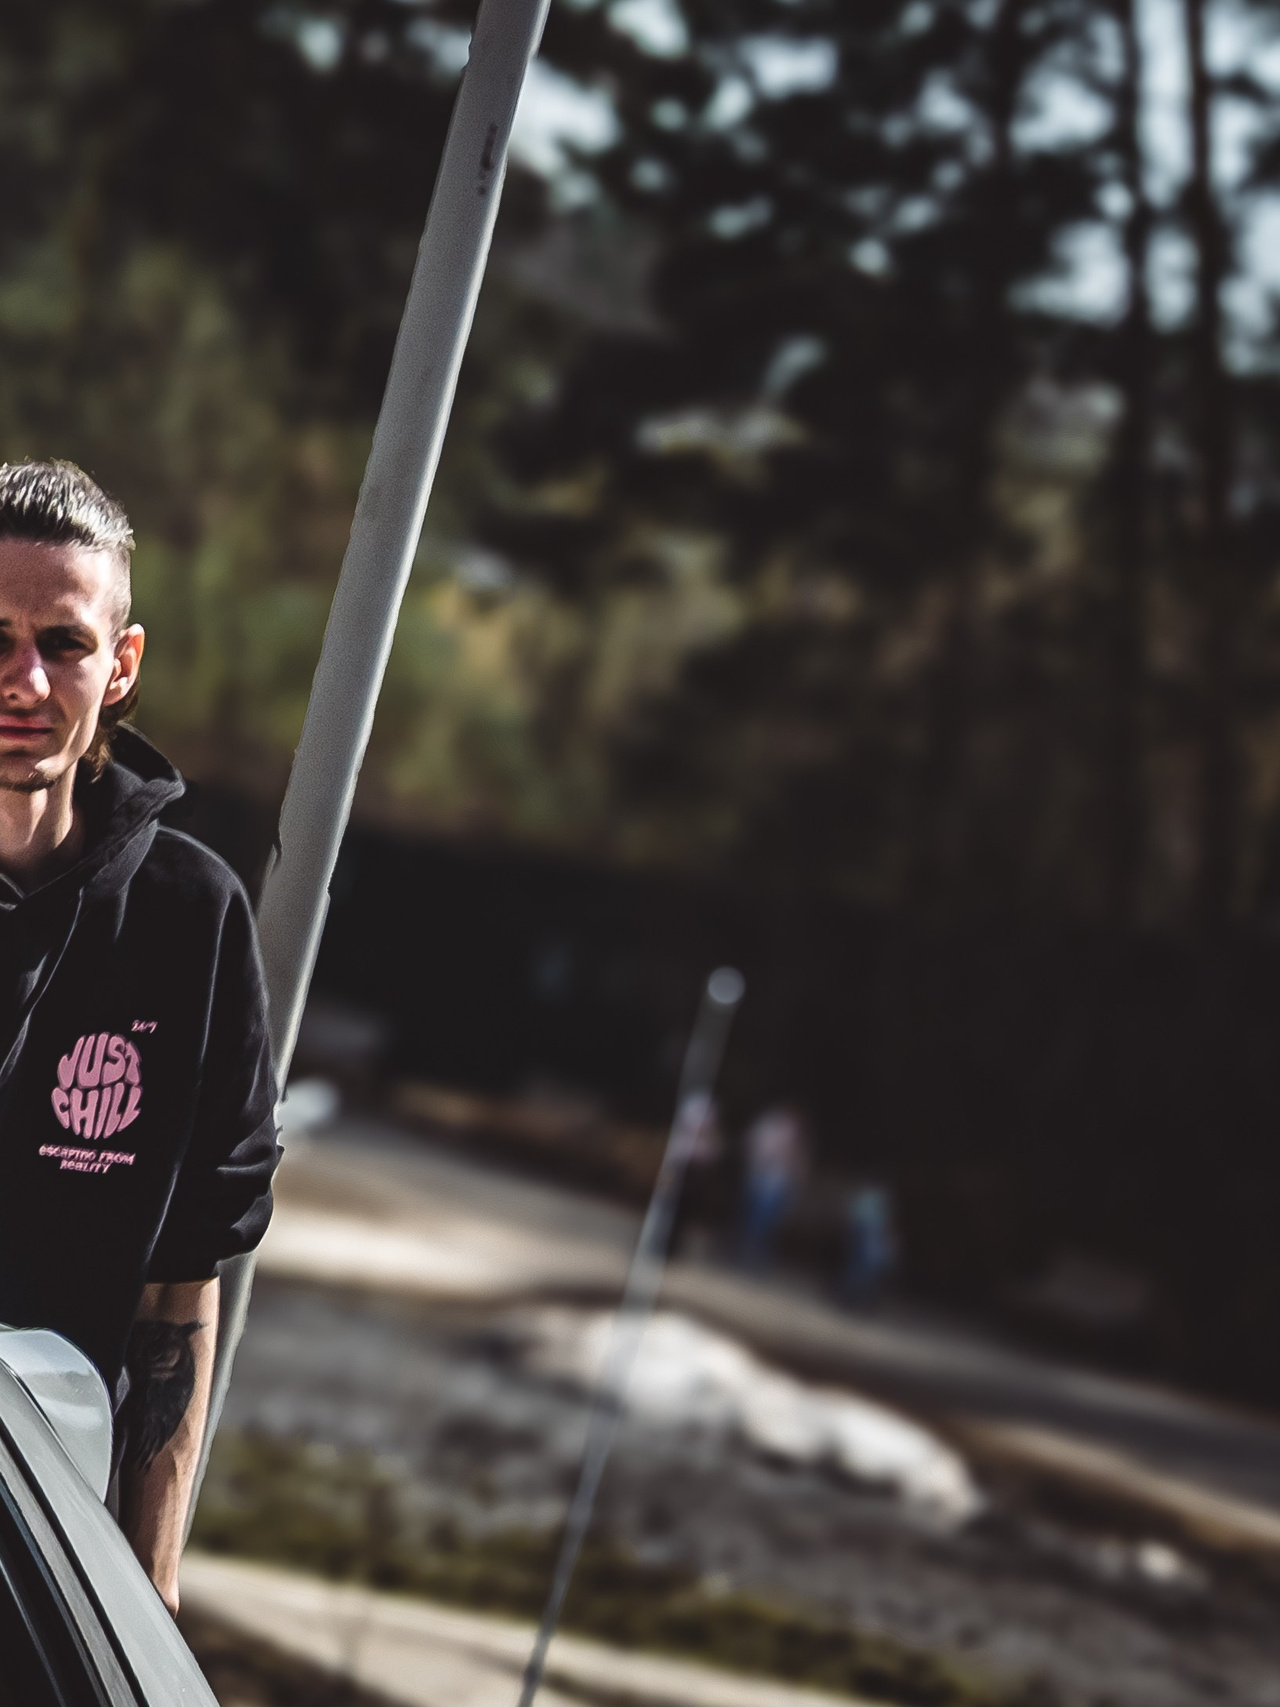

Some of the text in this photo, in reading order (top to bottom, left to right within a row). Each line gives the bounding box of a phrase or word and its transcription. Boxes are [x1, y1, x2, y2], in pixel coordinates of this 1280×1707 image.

[57, 1031, 142, 1090] JUST
[51, 1082, 143, 1140] CHILL
[98, 1151, 136, 1166] FROM
